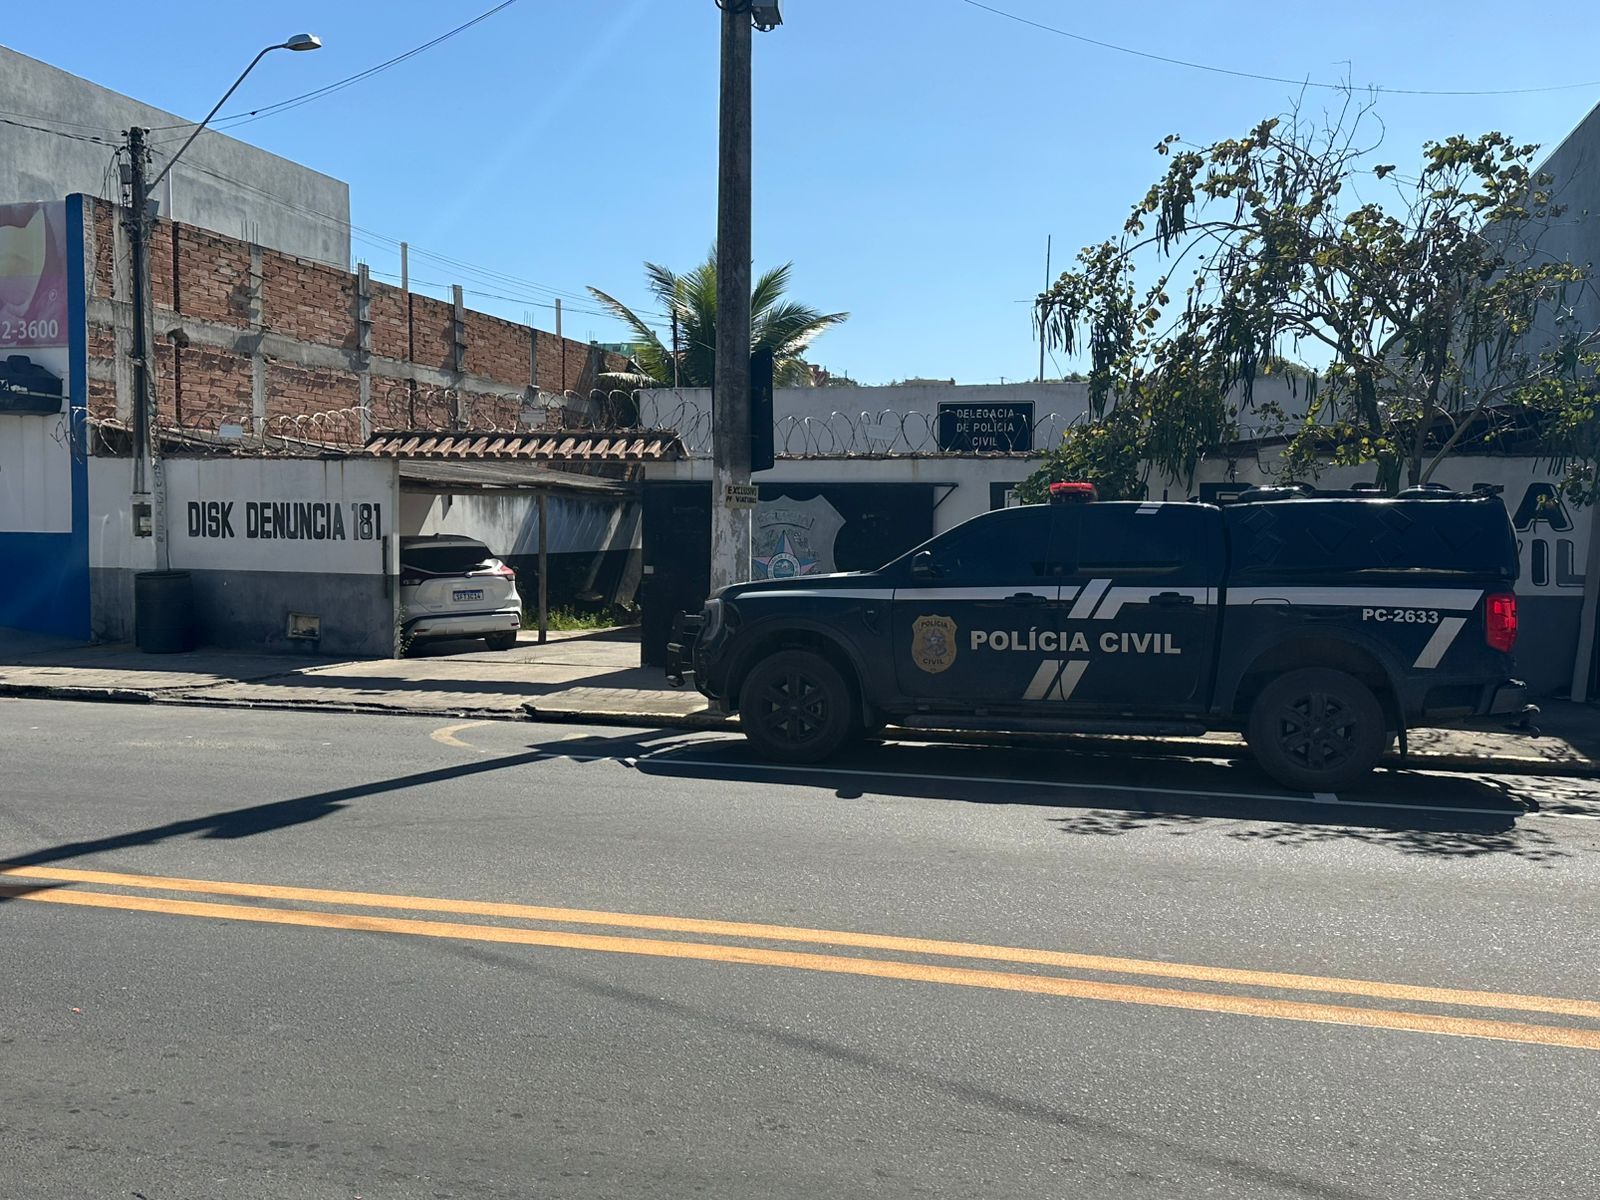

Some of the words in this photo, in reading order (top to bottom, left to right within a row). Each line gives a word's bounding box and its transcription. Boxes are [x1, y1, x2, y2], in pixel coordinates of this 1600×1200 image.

[956, 408, 1014, 419] DELEGACIA
[956, 423, 969, 433] DE
[972, 437, 998, 447] CIVIL
[187, 501, 235, 539] DISK
[246, 501, 346, 540] DENUNCIA
[351, 503, 381, 541] 181
[1362, 608, 1439, 624] PC-2633
[970, 626, 1090, 652] POLÍCIA
[1100, 632, 1182, 654] CIVIL
